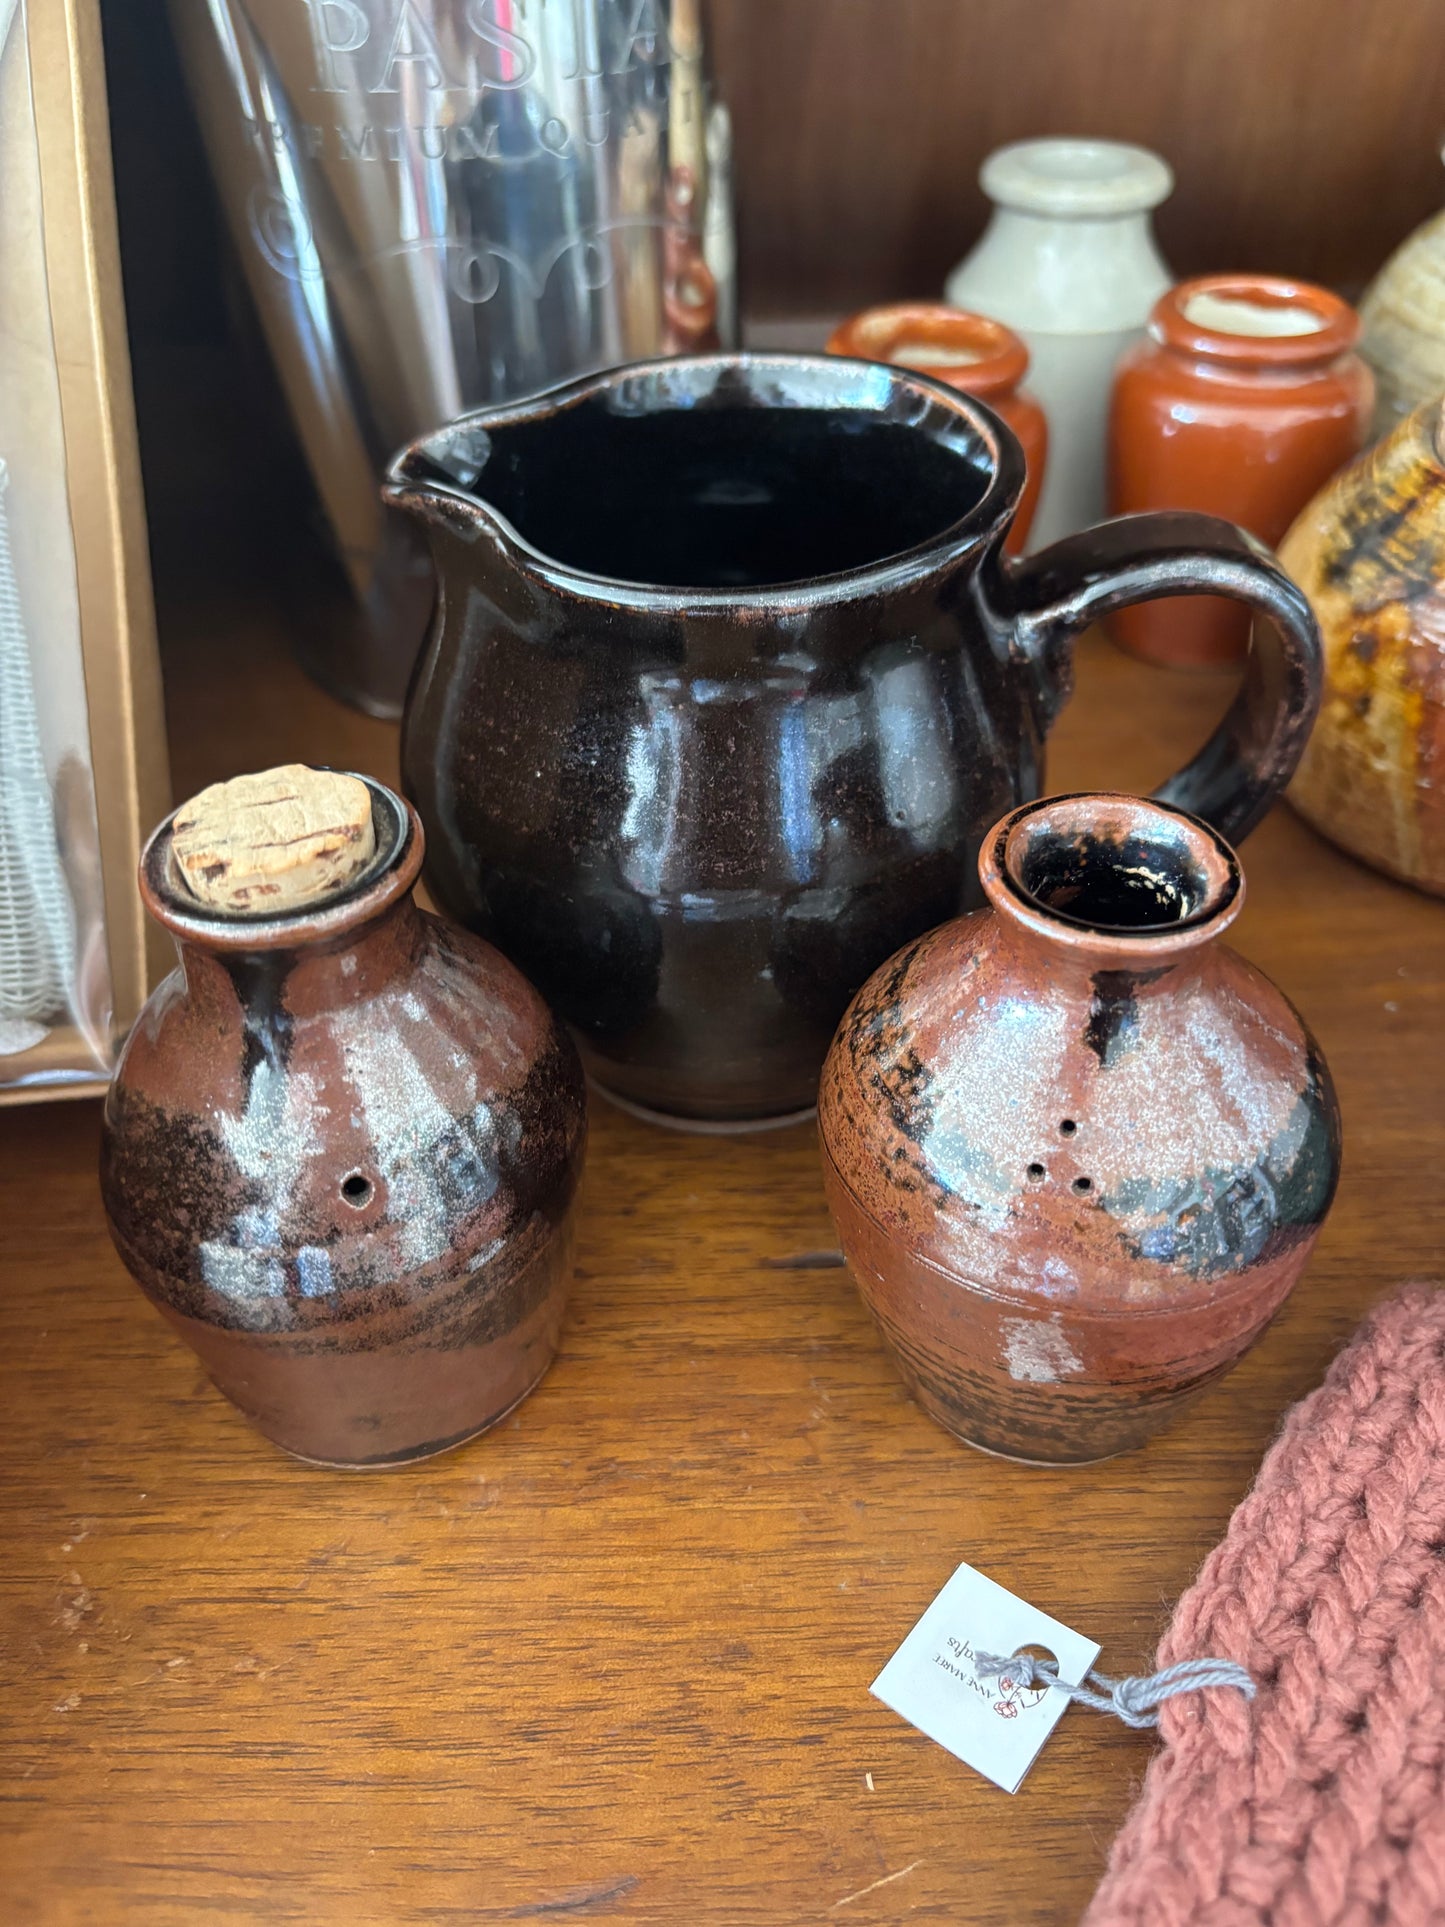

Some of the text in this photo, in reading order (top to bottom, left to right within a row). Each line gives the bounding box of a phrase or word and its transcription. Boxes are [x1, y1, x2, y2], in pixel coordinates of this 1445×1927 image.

[302, 0, 686, 93] PASTA
[932, 1654, 996, 1699] ANNE MAREE
